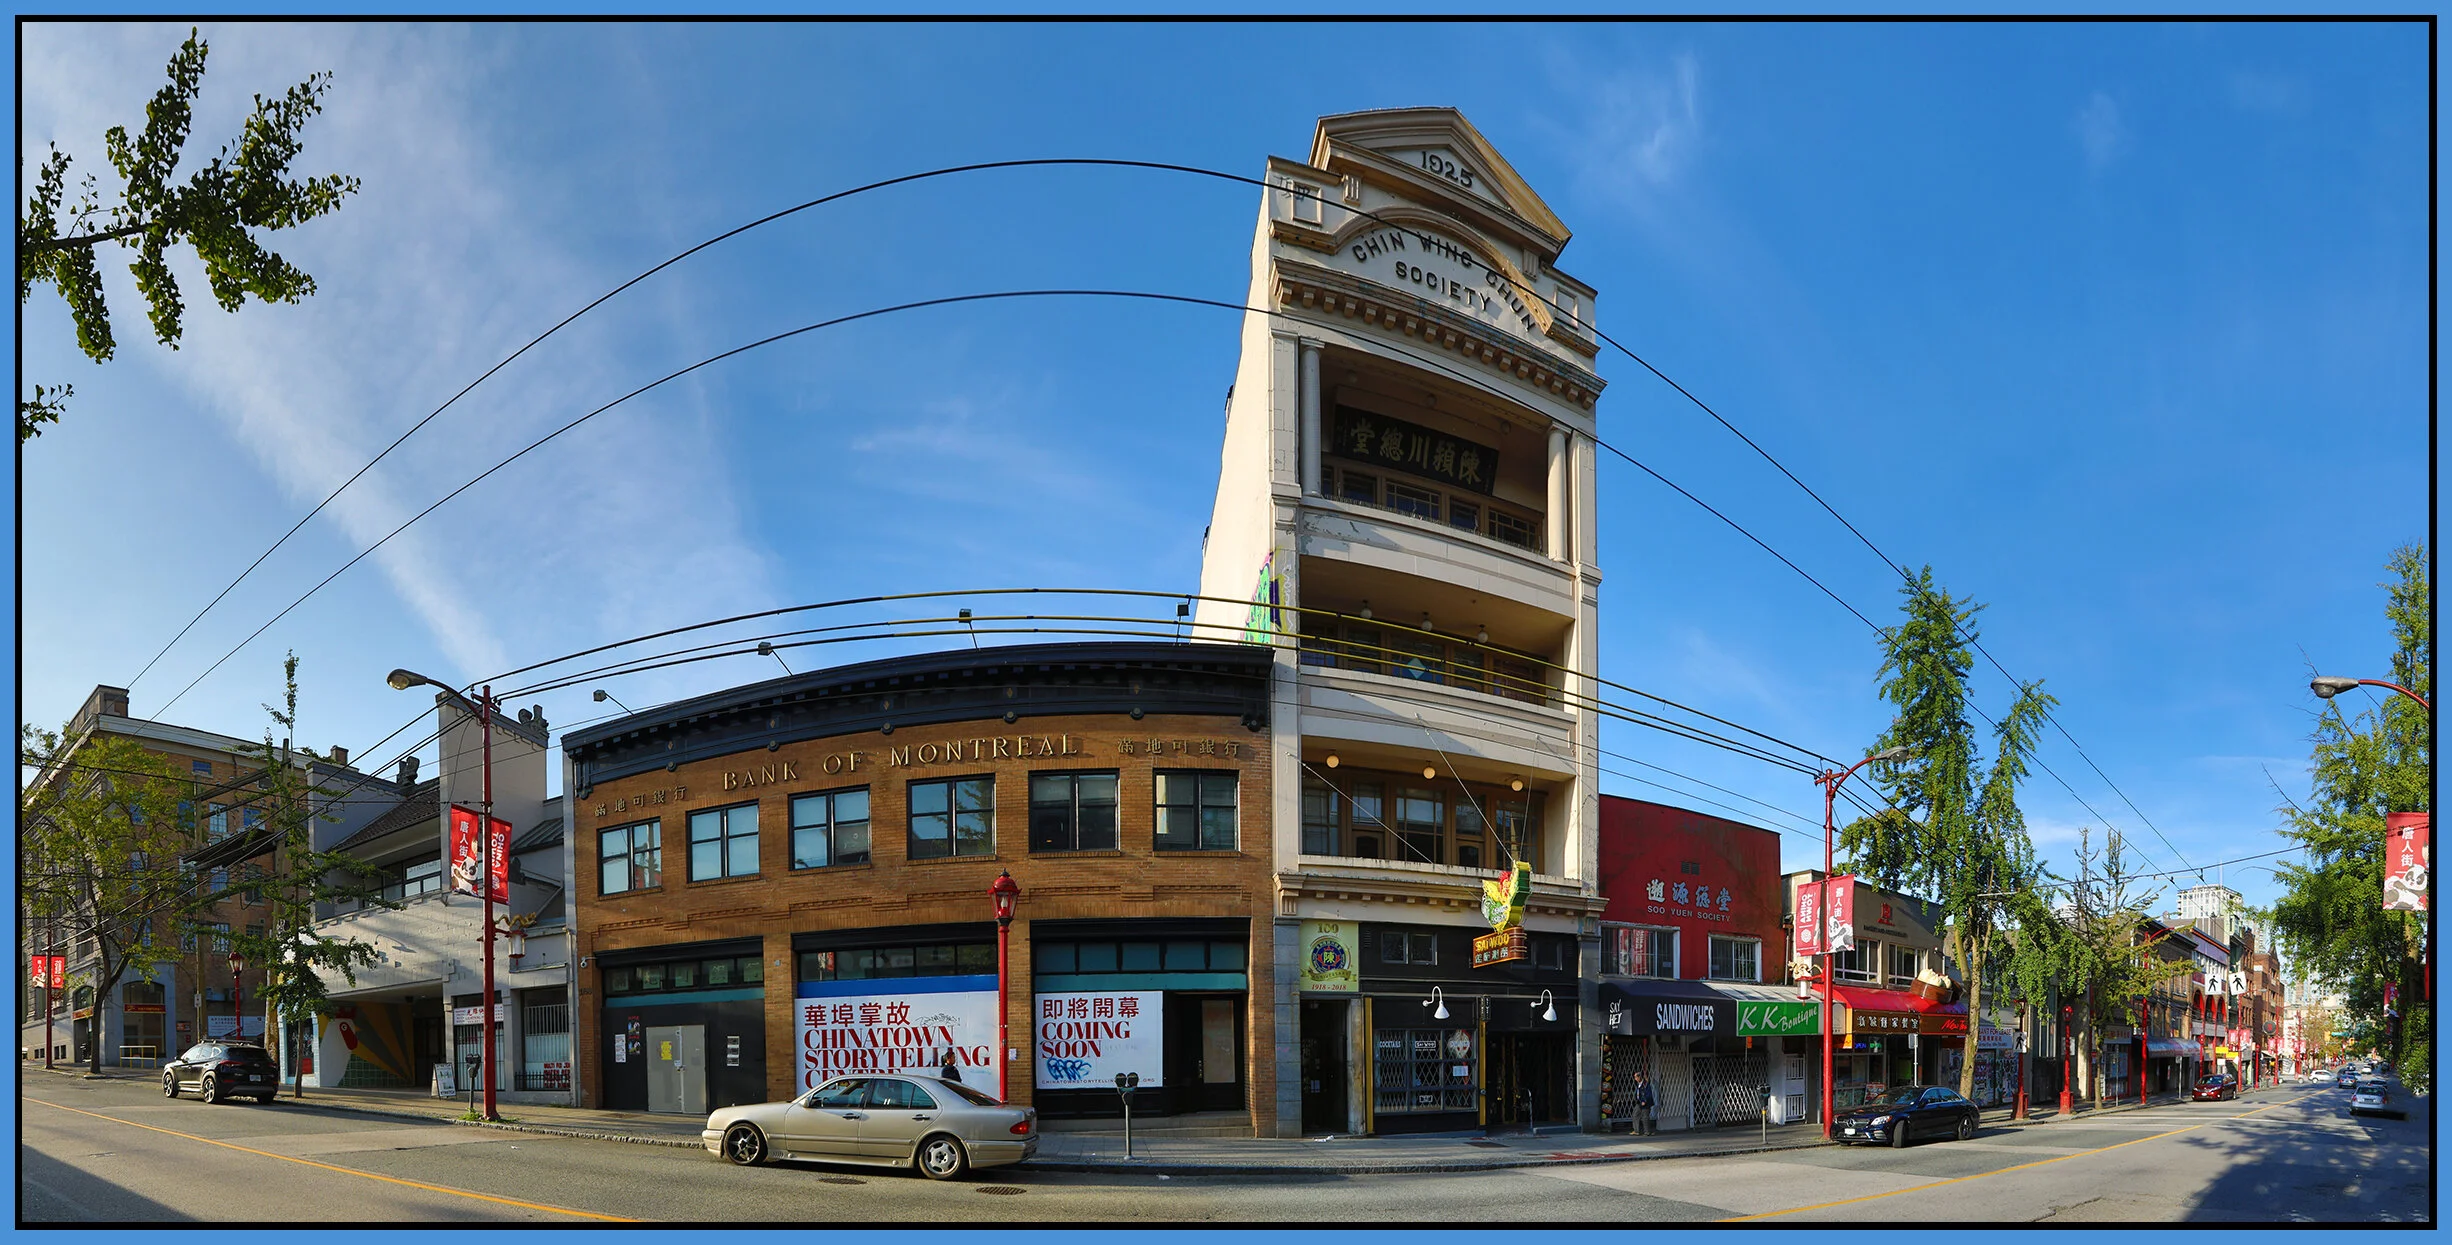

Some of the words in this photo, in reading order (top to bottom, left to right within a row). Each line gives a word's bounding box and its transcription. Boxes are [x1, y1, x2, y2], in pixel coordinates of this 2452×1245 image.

[1421, 151, 1474, 188] 1925
[1351, 231, 1405, 263] CHIN
[1417, 231, 1473, 268] WING
[1485, 270, 1536, 332] CHUN
[1395, 260, 1491, 312] SOCIETY
[723, 760, 798, 791] BANK
[823, 751, 863, 775] OF
[890, 733, 1078, 768] MONTREAL
[495, 833, 505, 868] CHINA
[1647, 905, 1665, 914] SOO
[1671, 908, 1693, 917] YUEN
[1697, 912, 1731, 922] SOCIETY
[804, 1001, 911, 1028] 華埠掌故
[1042, 997, 1139, 1020] 即將開幕
[1609, 998, 1622, 1014] SAY
[1609, 1012, 1622, 1026] HEY
[1656, 1002, 1715, 1031] SANDWICHES
[1781, 1005, 1818, 1032] Boutique
[804, 1024, 955, 1049] CHINATOWN
[1042, 1020, 1130, 1041] COMING
[1042, 1039, 1101, 1059] SOON
